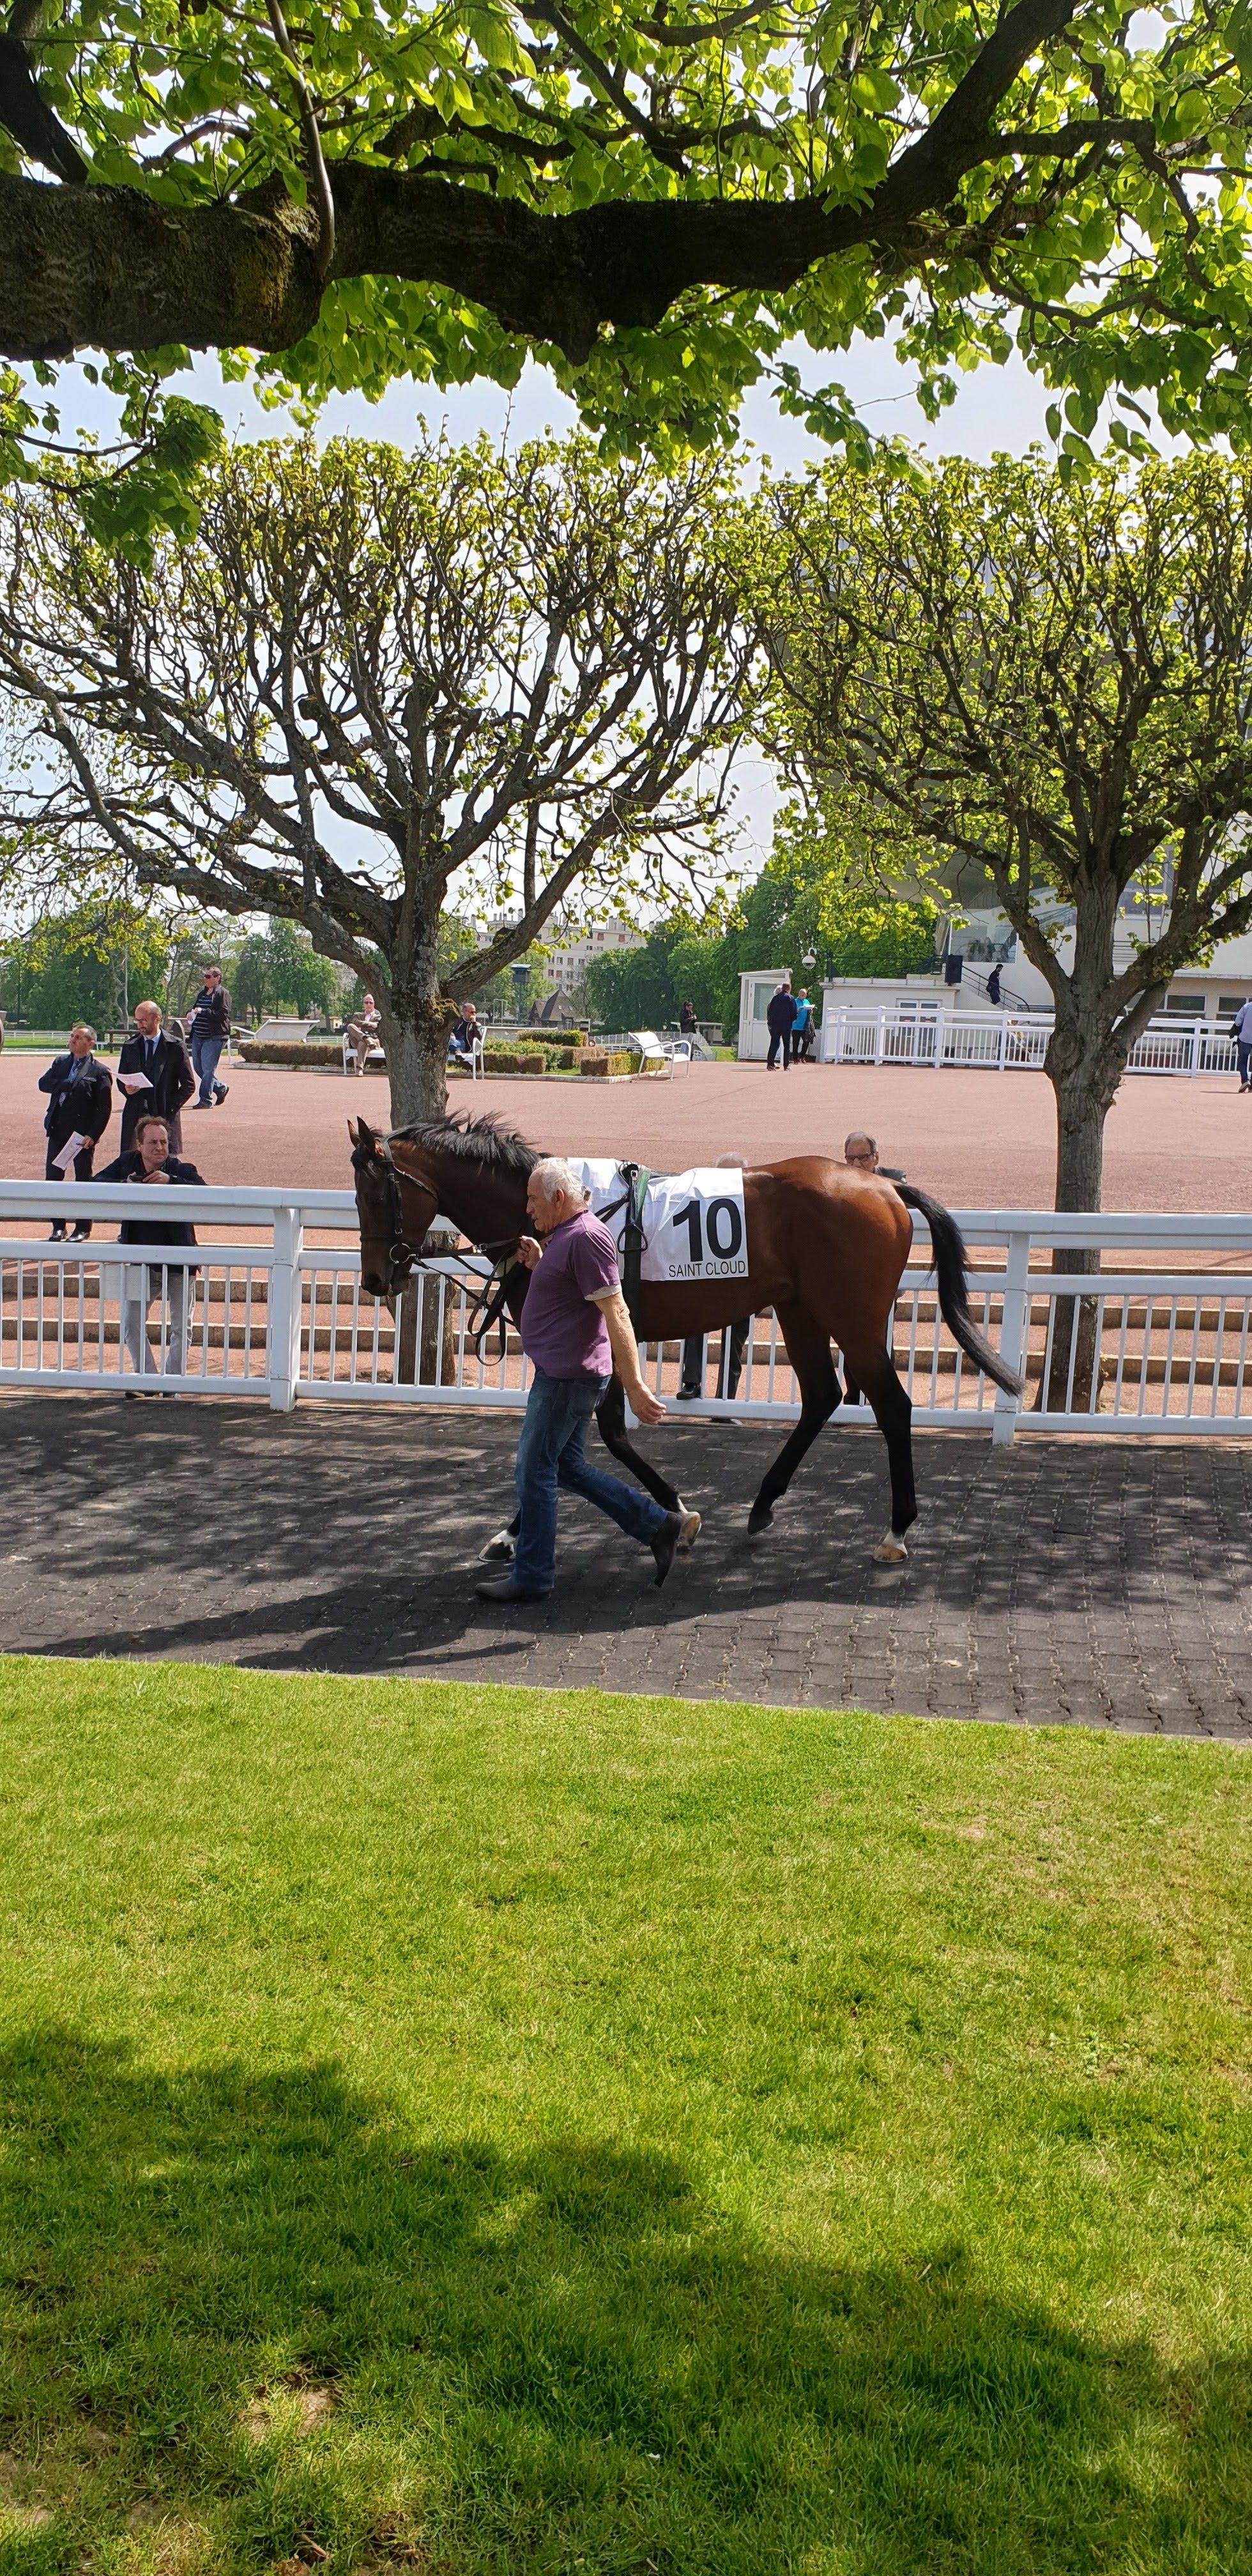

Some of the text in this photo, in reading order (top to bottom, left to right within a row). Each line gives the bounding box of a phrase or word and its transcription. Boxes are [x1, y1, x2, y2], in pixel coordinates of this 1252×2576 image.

[673, 1198, 742, 1262] 10
[669, 1261, 746, 1277] SAINT CLOUD
